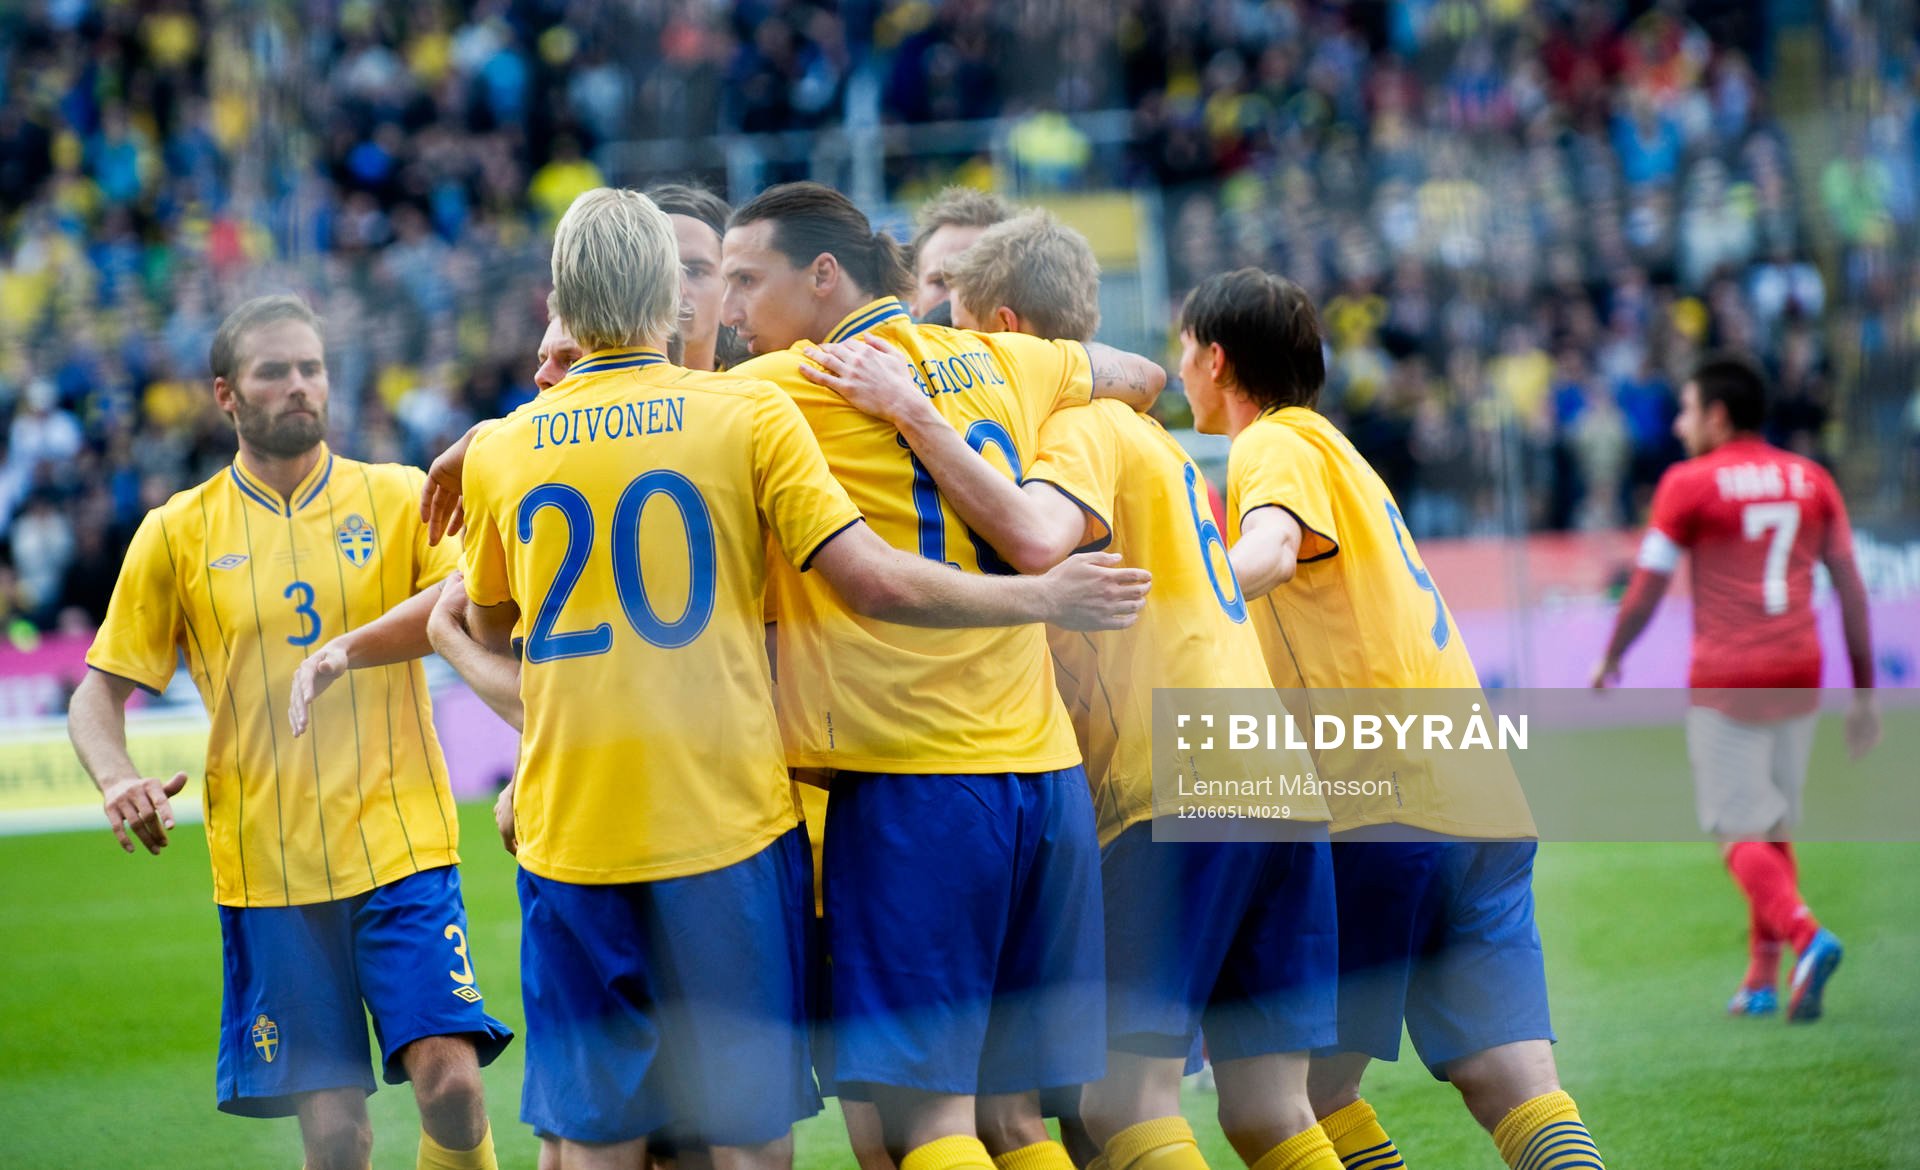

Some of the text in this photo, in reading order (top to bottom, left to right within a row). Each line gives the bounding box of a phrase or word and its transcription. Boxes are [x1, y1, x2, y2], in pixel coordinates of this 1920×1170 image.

[532, 397, 685, 449] TOIVONEN
[517, 469, 717, 664] 20
[1184, 461, 1248, 624] 6
[1384, 498, 1450, 651] 9
[1742, 501, 1801, 616] 7
[283, 581, 322, 646] 3
[444, 924, 475, 985] 3
